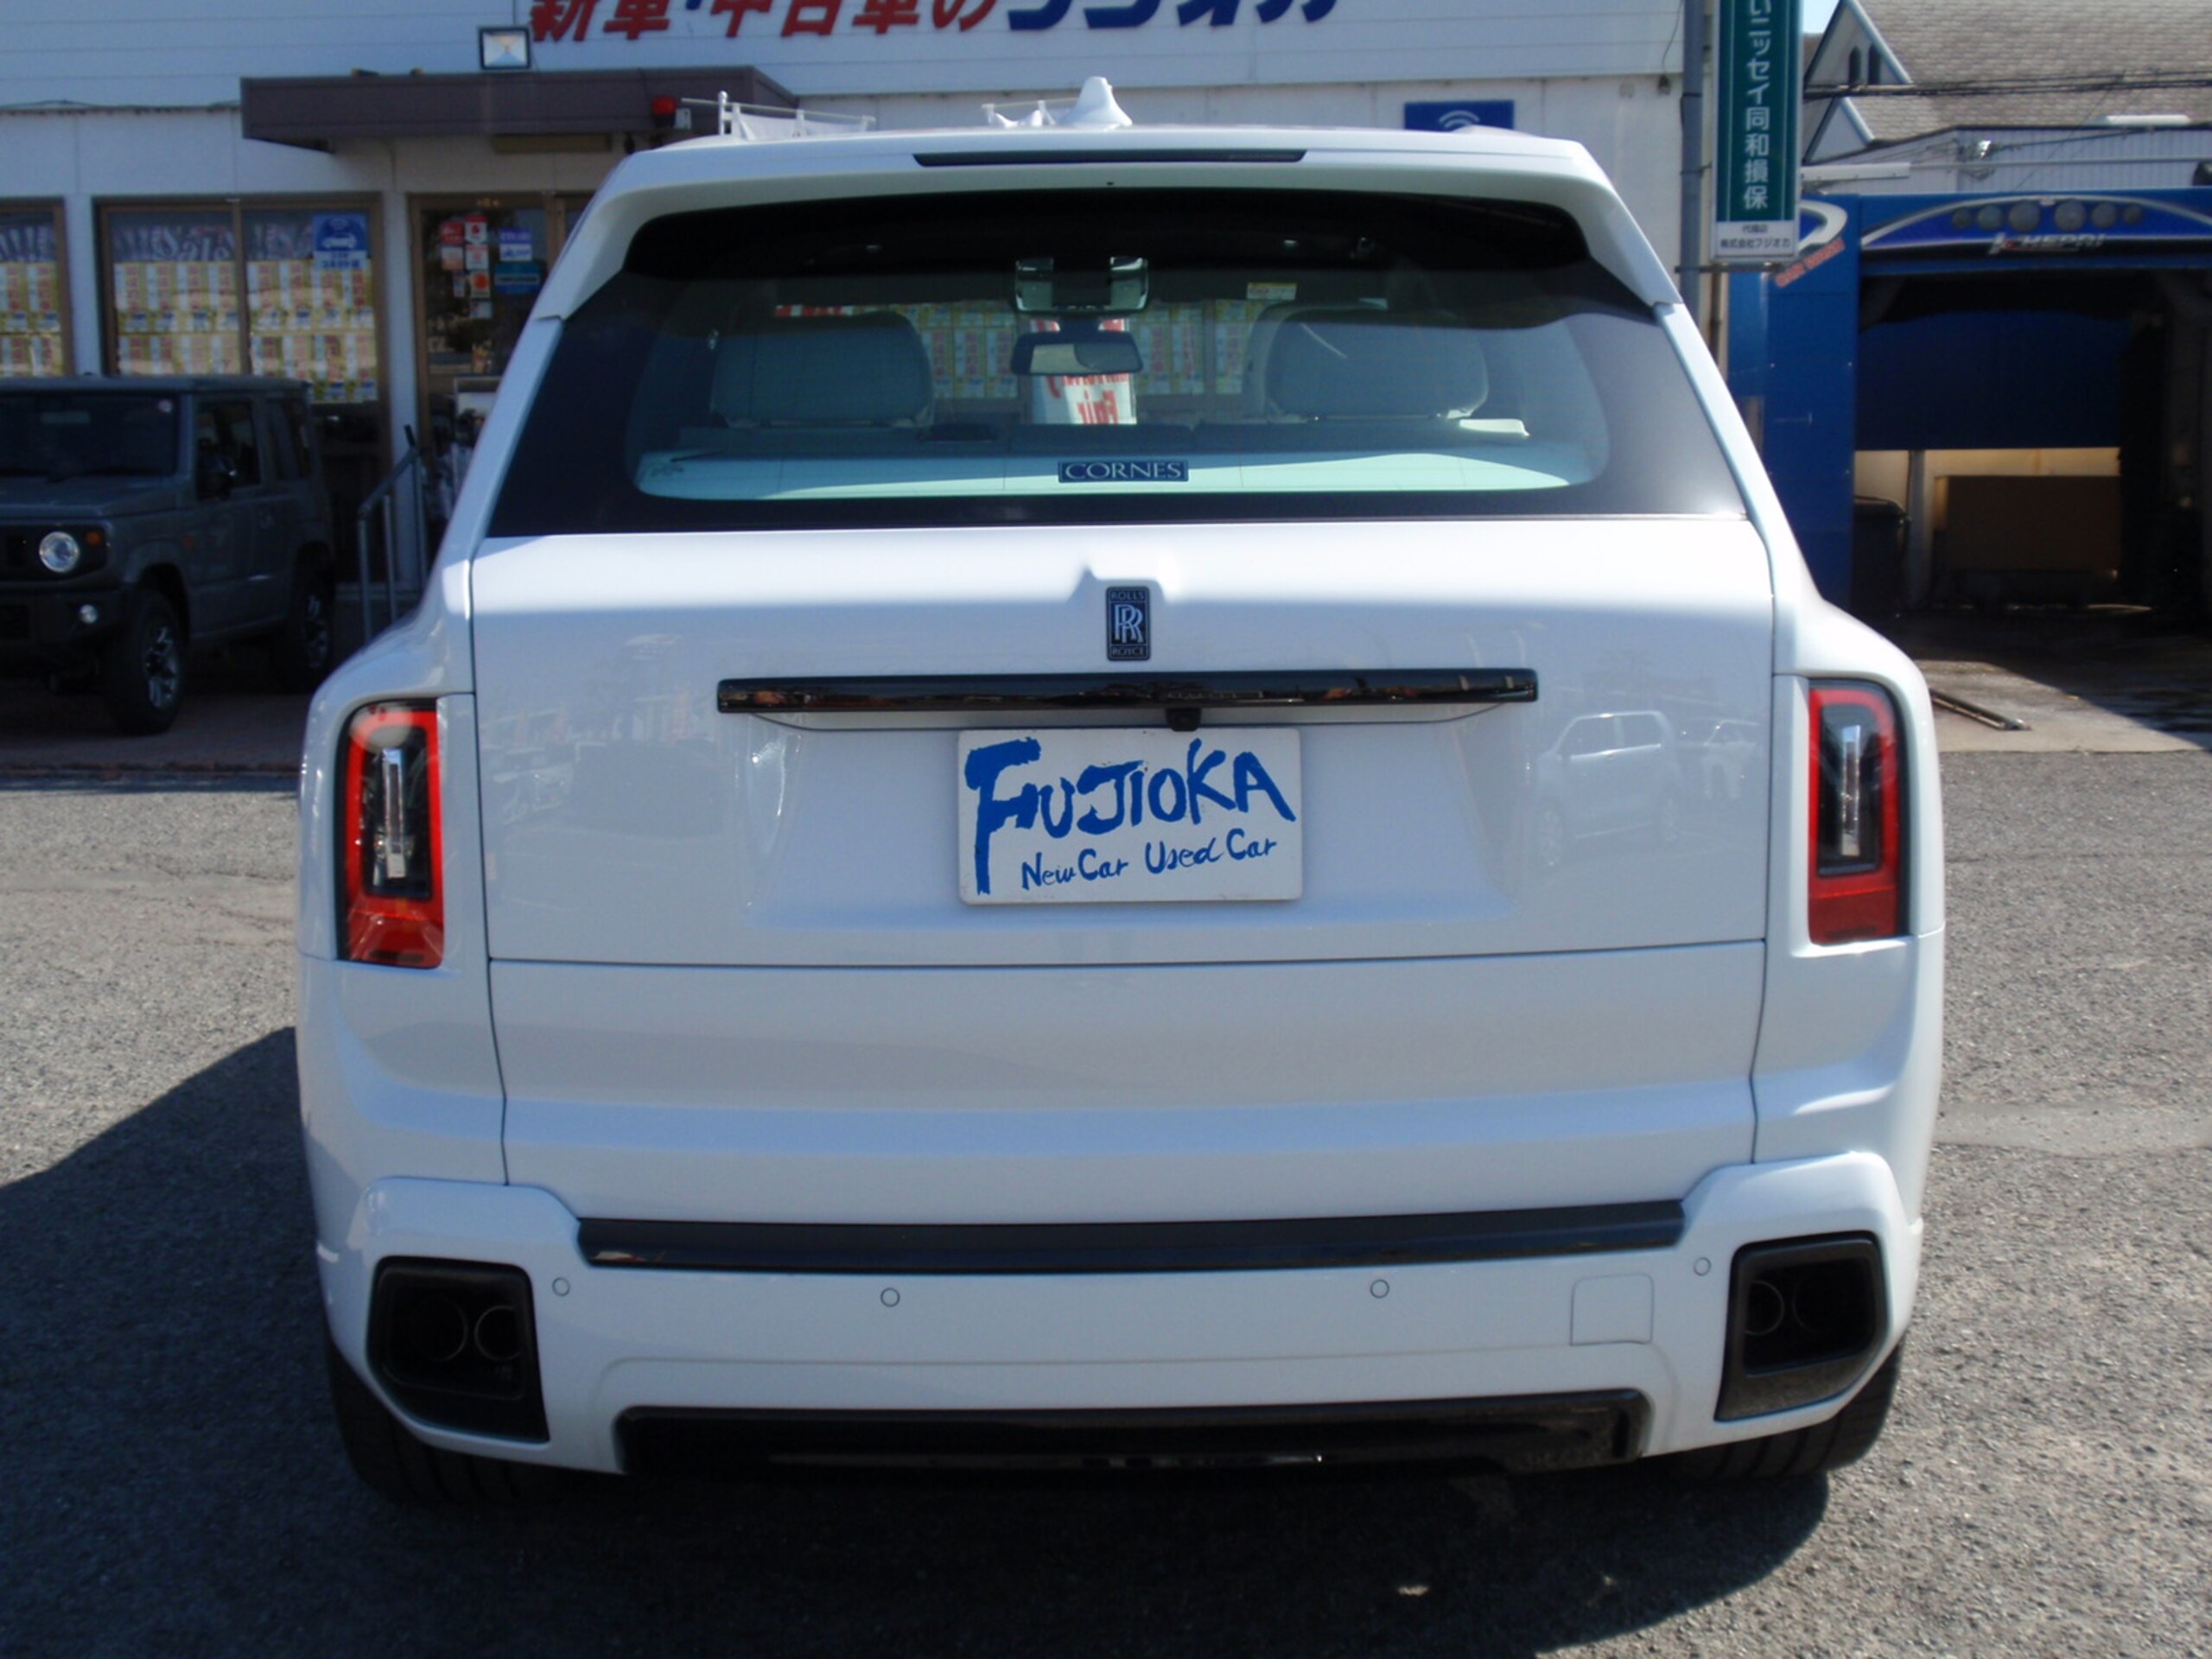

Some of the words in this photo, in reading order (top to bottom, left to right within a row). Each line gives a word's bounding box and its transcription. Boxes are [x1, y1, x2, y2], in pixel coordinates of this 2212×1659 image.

[1065, 462, 1181, 479] CORNES
[964, 737, 1296, 895] FUJIOKA
[1021, 853, 1076, 890] New
[1077, 849, 1128, 880] Car
[1145, 837, 1224, 874] Used
[1226, 828, 1277, 859] Car
